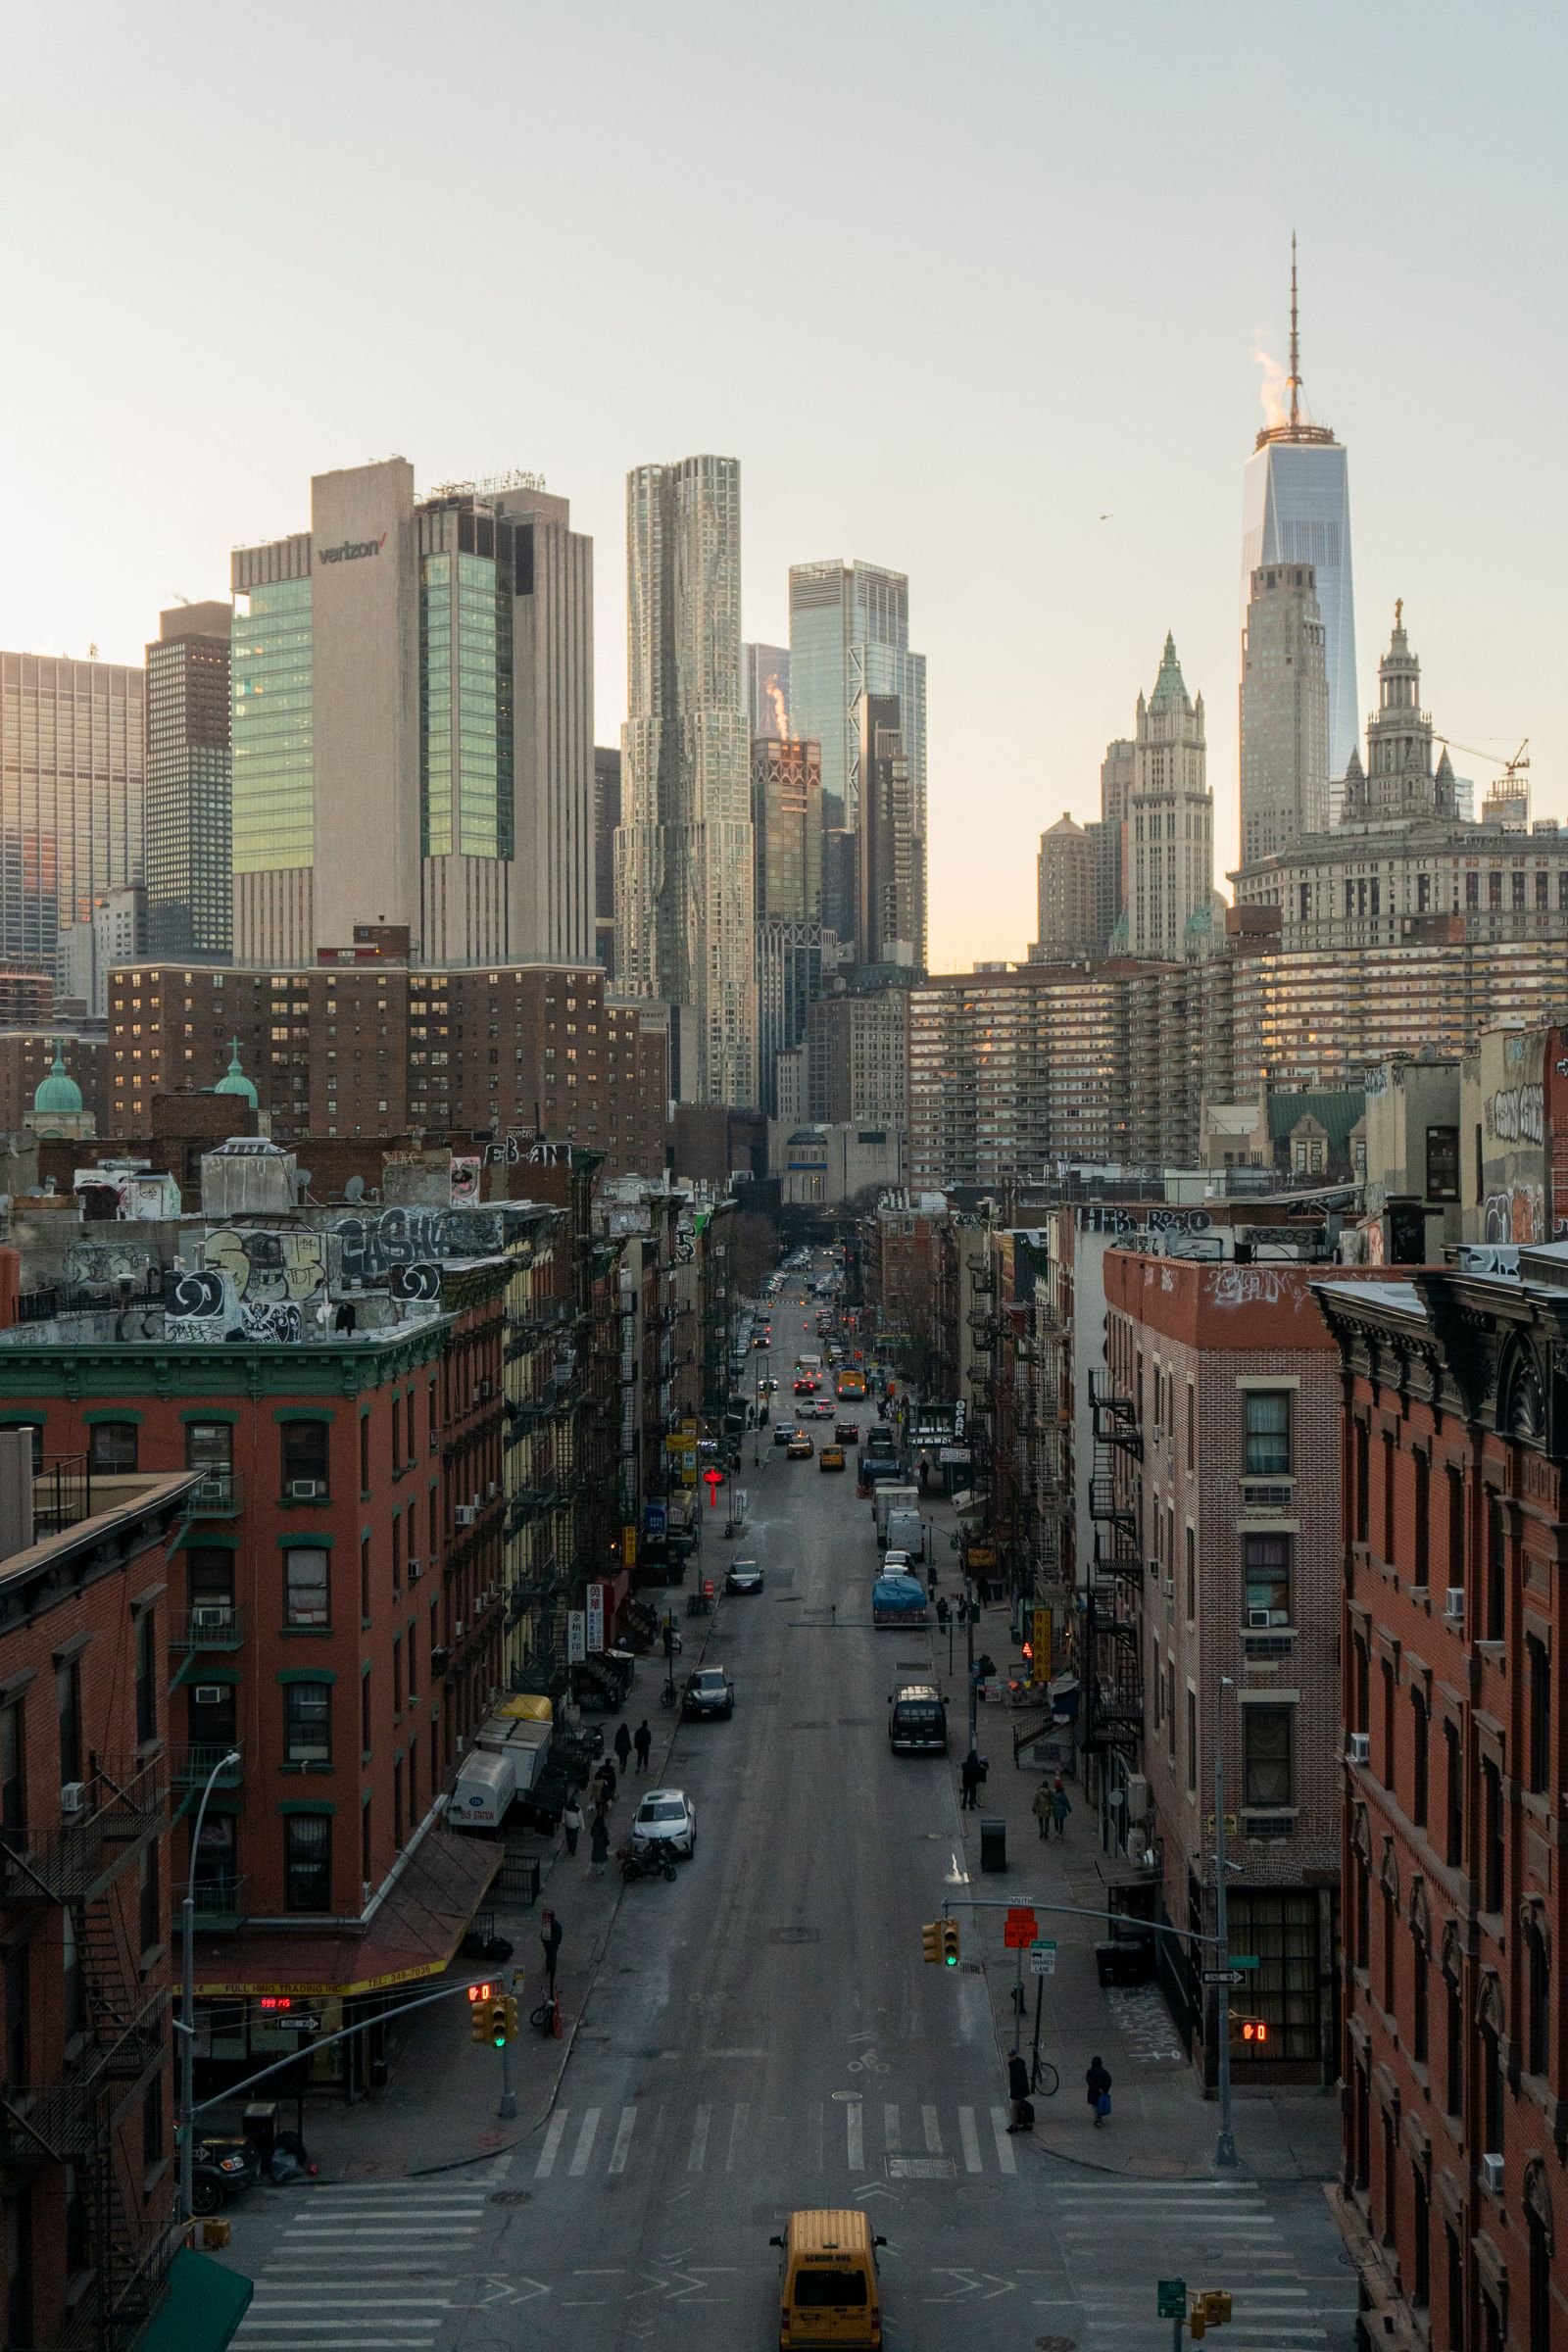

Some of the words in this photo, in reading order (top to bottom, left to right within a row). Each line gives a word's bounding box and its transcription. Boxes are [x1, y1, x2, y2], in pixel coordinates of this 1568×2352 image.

[318, 540, 379, 564] verizon
[956, 1409, 965, 1437] PARK
[473, 1811, 495, 1820] STATION
[367, 1977, 387, 1987] TEL:
[225, 1984, 248, 1993] FULL
[252, 1984, 275, 1993] HING
[278, 1984, 322, 1993] TRADING
[836, 2254, 852, 2263] BUS
